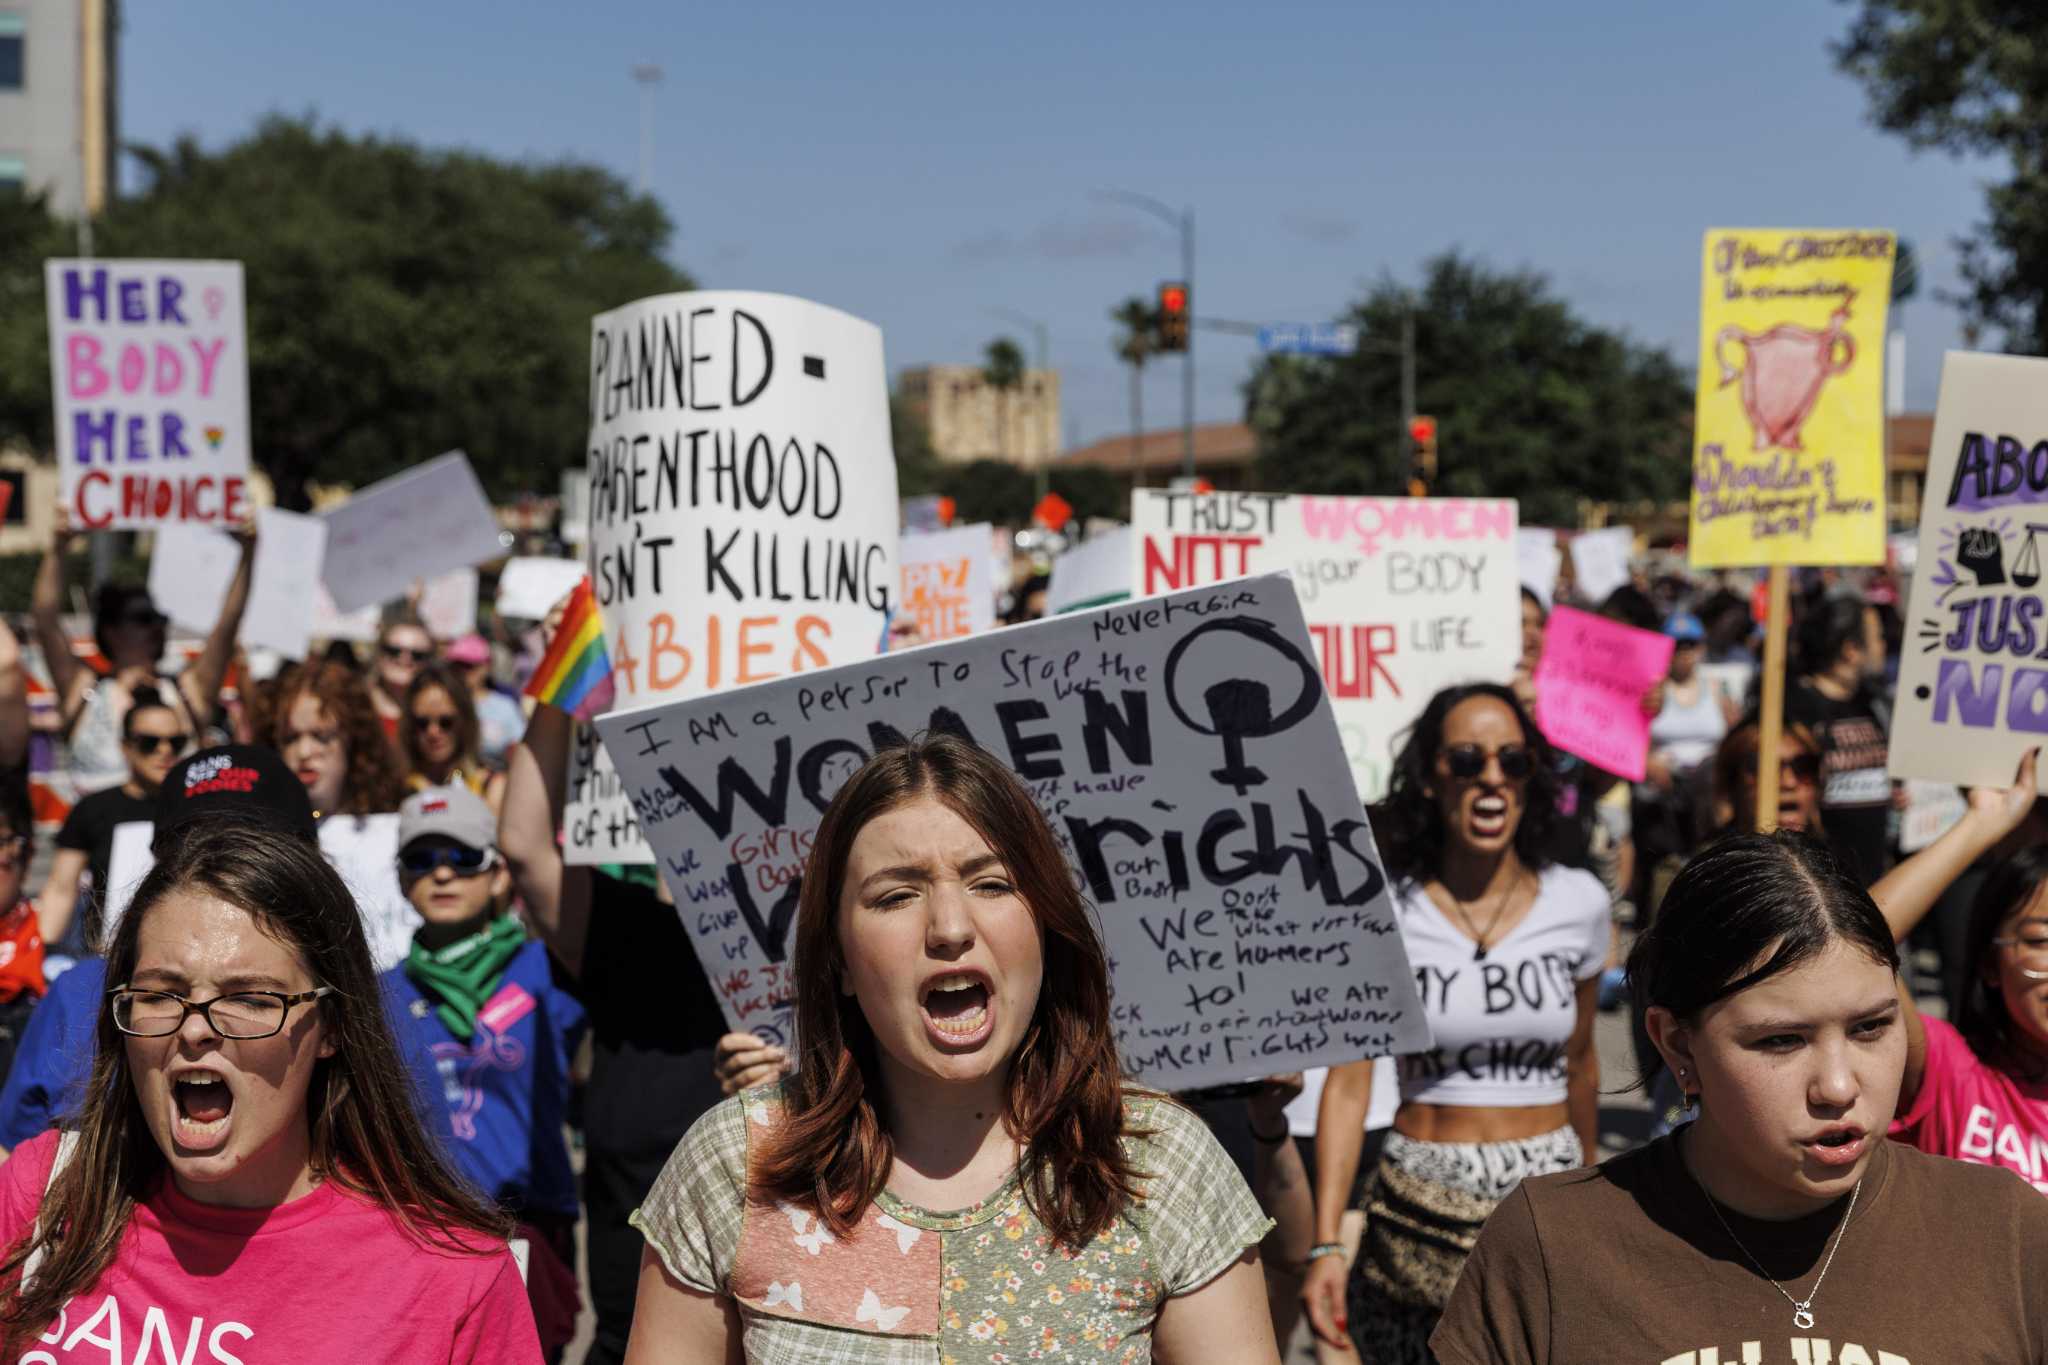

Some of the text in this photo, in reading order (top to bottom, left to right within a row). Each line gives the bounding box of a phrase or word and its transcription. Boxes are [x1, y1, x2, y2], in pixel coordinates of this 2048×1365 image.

[64, 269, 187, 324] HER
[66, 333, 225, 399] BODY
[593, 309, 774, 422] PLANNED
[73, 410, 190, 464] HER
[76, 469, 245, 528] CHOICE
[591, 430, 842, 527] PARENTHOOD
[1149, 491, 1512, 557] TRUST WOMEN
[705, 528, 889, 615] KILLING
[1143, 536, 1487, 600] NOT your BODY
[614, 612, 832, 694] ABIES
[1410, 616, 1483, 651] LIFE
[1946, 595, 2048, 660] JUS
[624, 718, 672, 757] I
[753, 711, 777, 726] a
[1098, 651, 1147, 683] the
[573, 806, 640, 848] of th
[1114, 856, 1160, 876] our
[1140, 907, 1218, 950] We
[1166, 947, 1225, 974] Are
